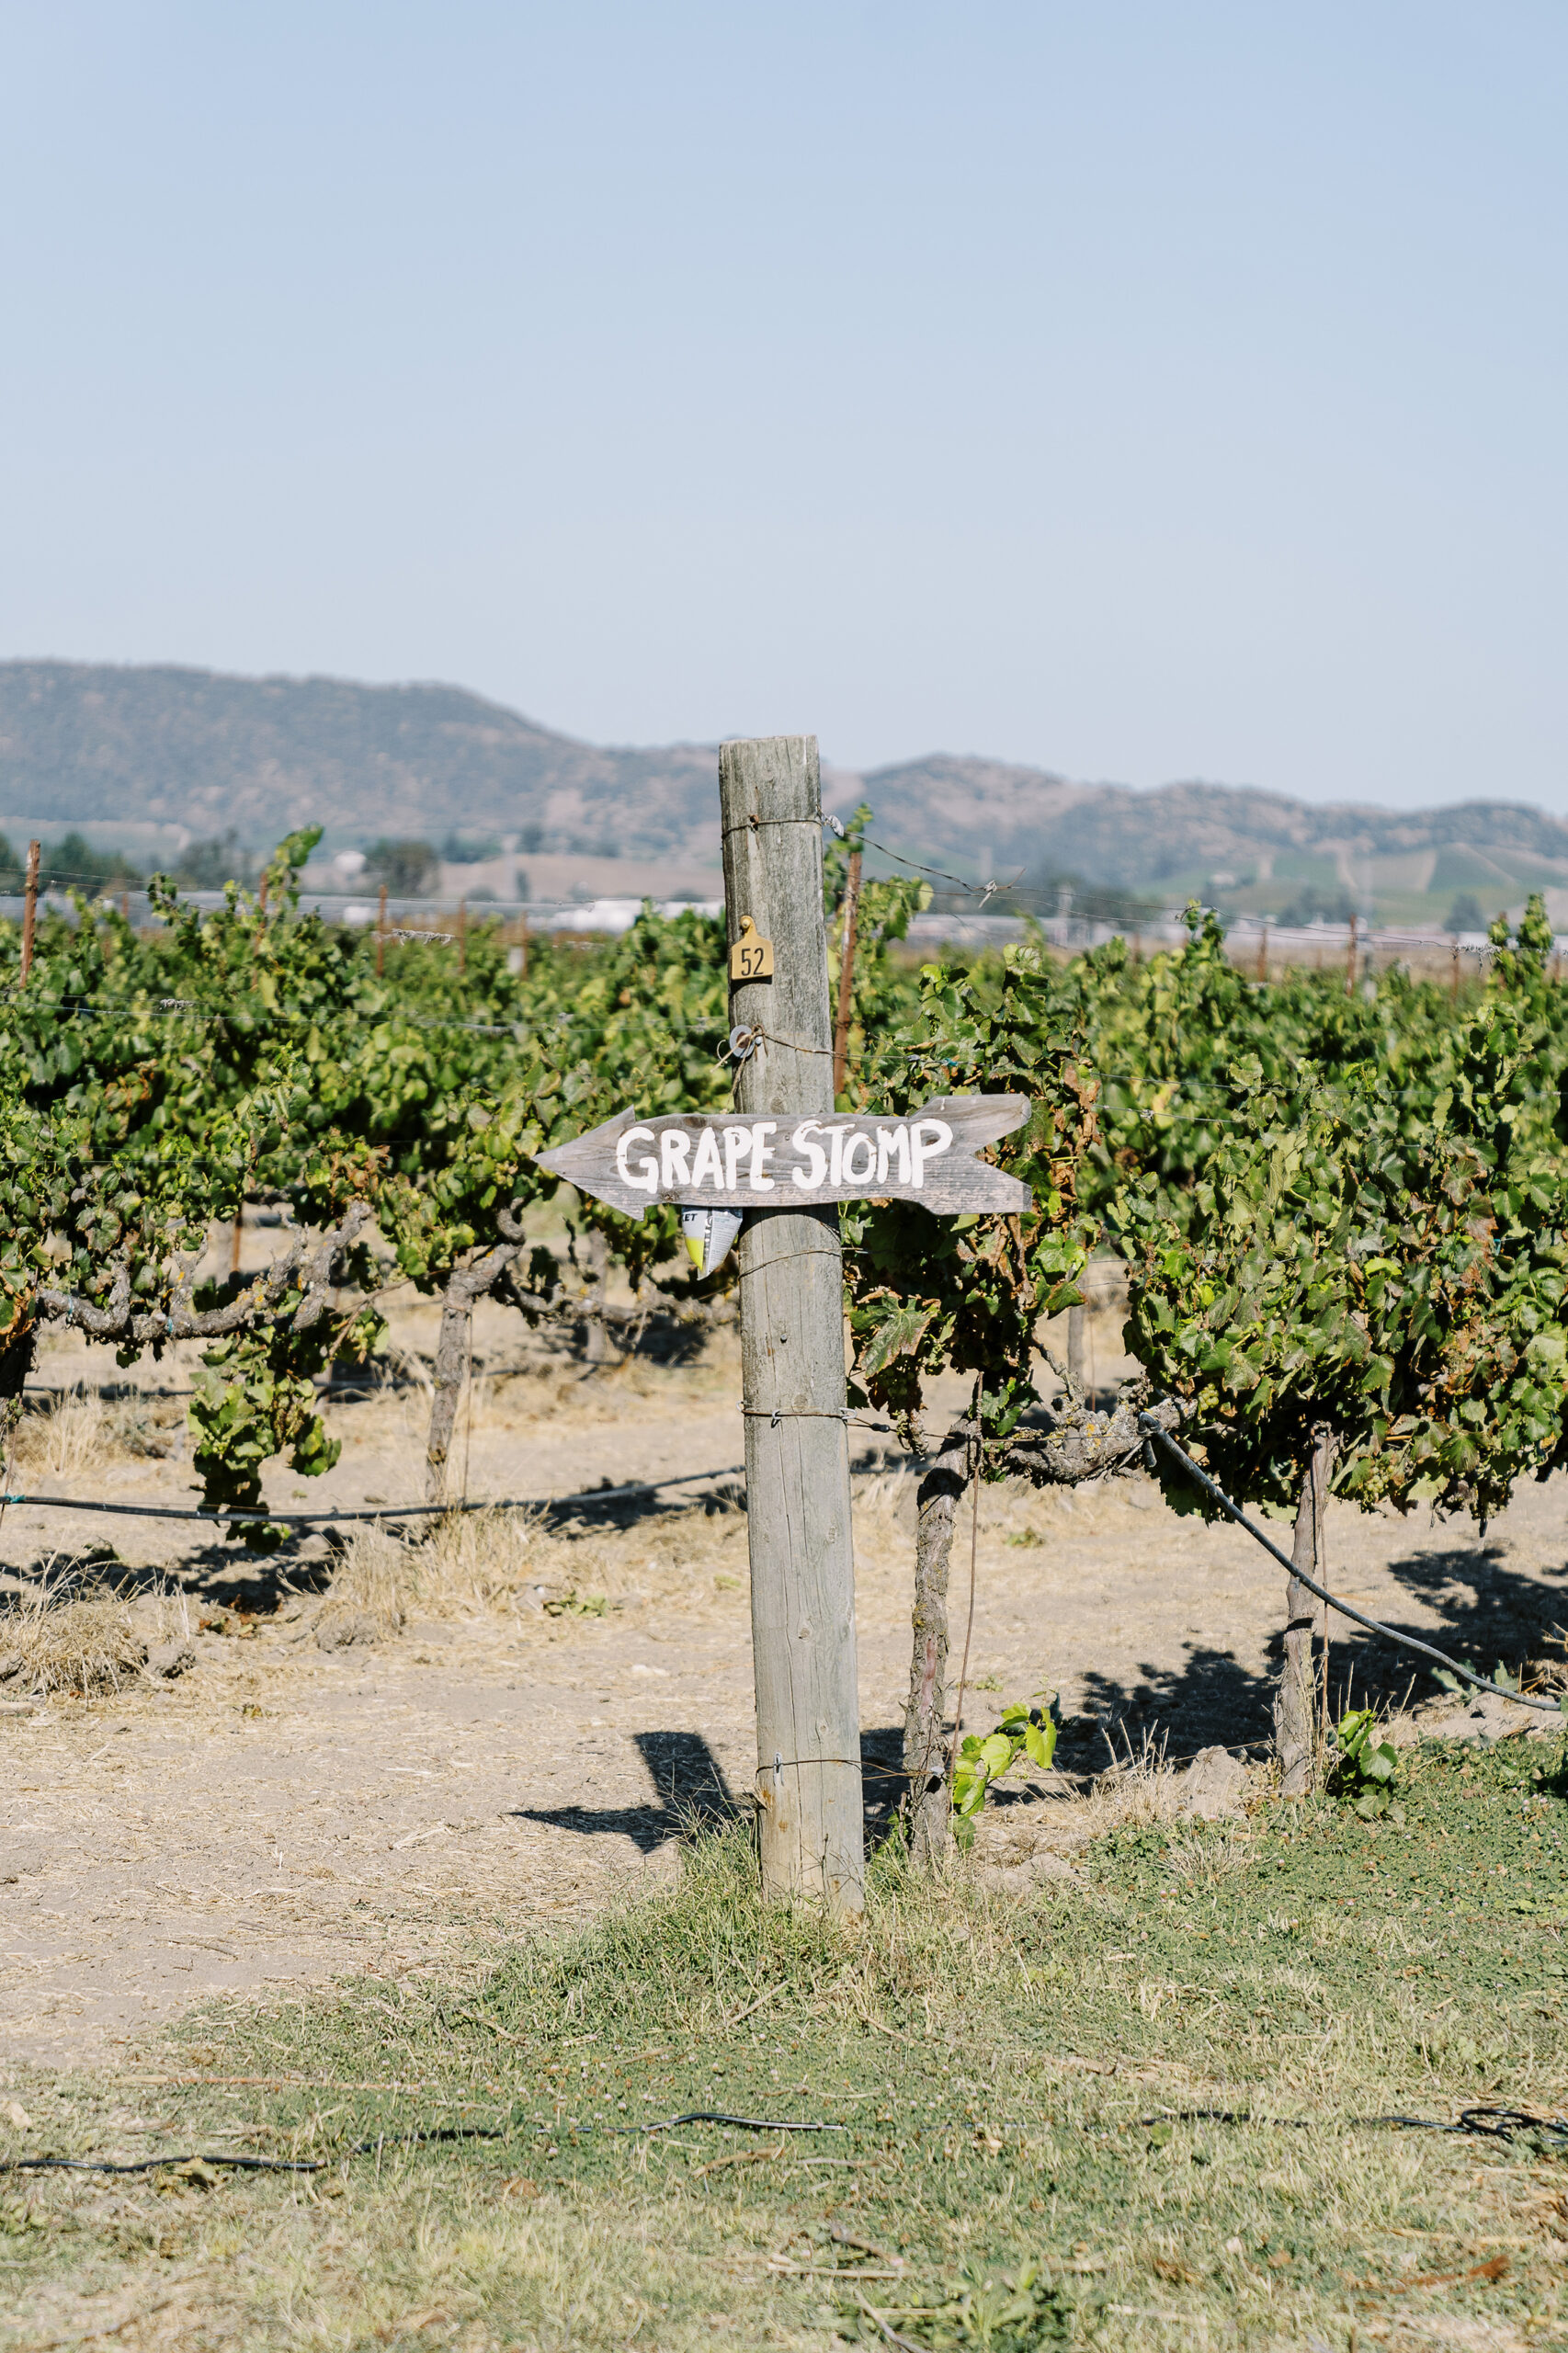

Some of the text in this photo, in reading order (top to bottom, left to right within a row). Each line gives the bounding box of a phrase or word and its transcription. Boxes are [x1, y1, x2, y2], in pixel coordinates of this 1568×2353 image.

[741, 948, 764, 977] 52
[616, 1118, 953, 1193] GRAPE STOMP
[683, 1213, 698, 1222] ET
